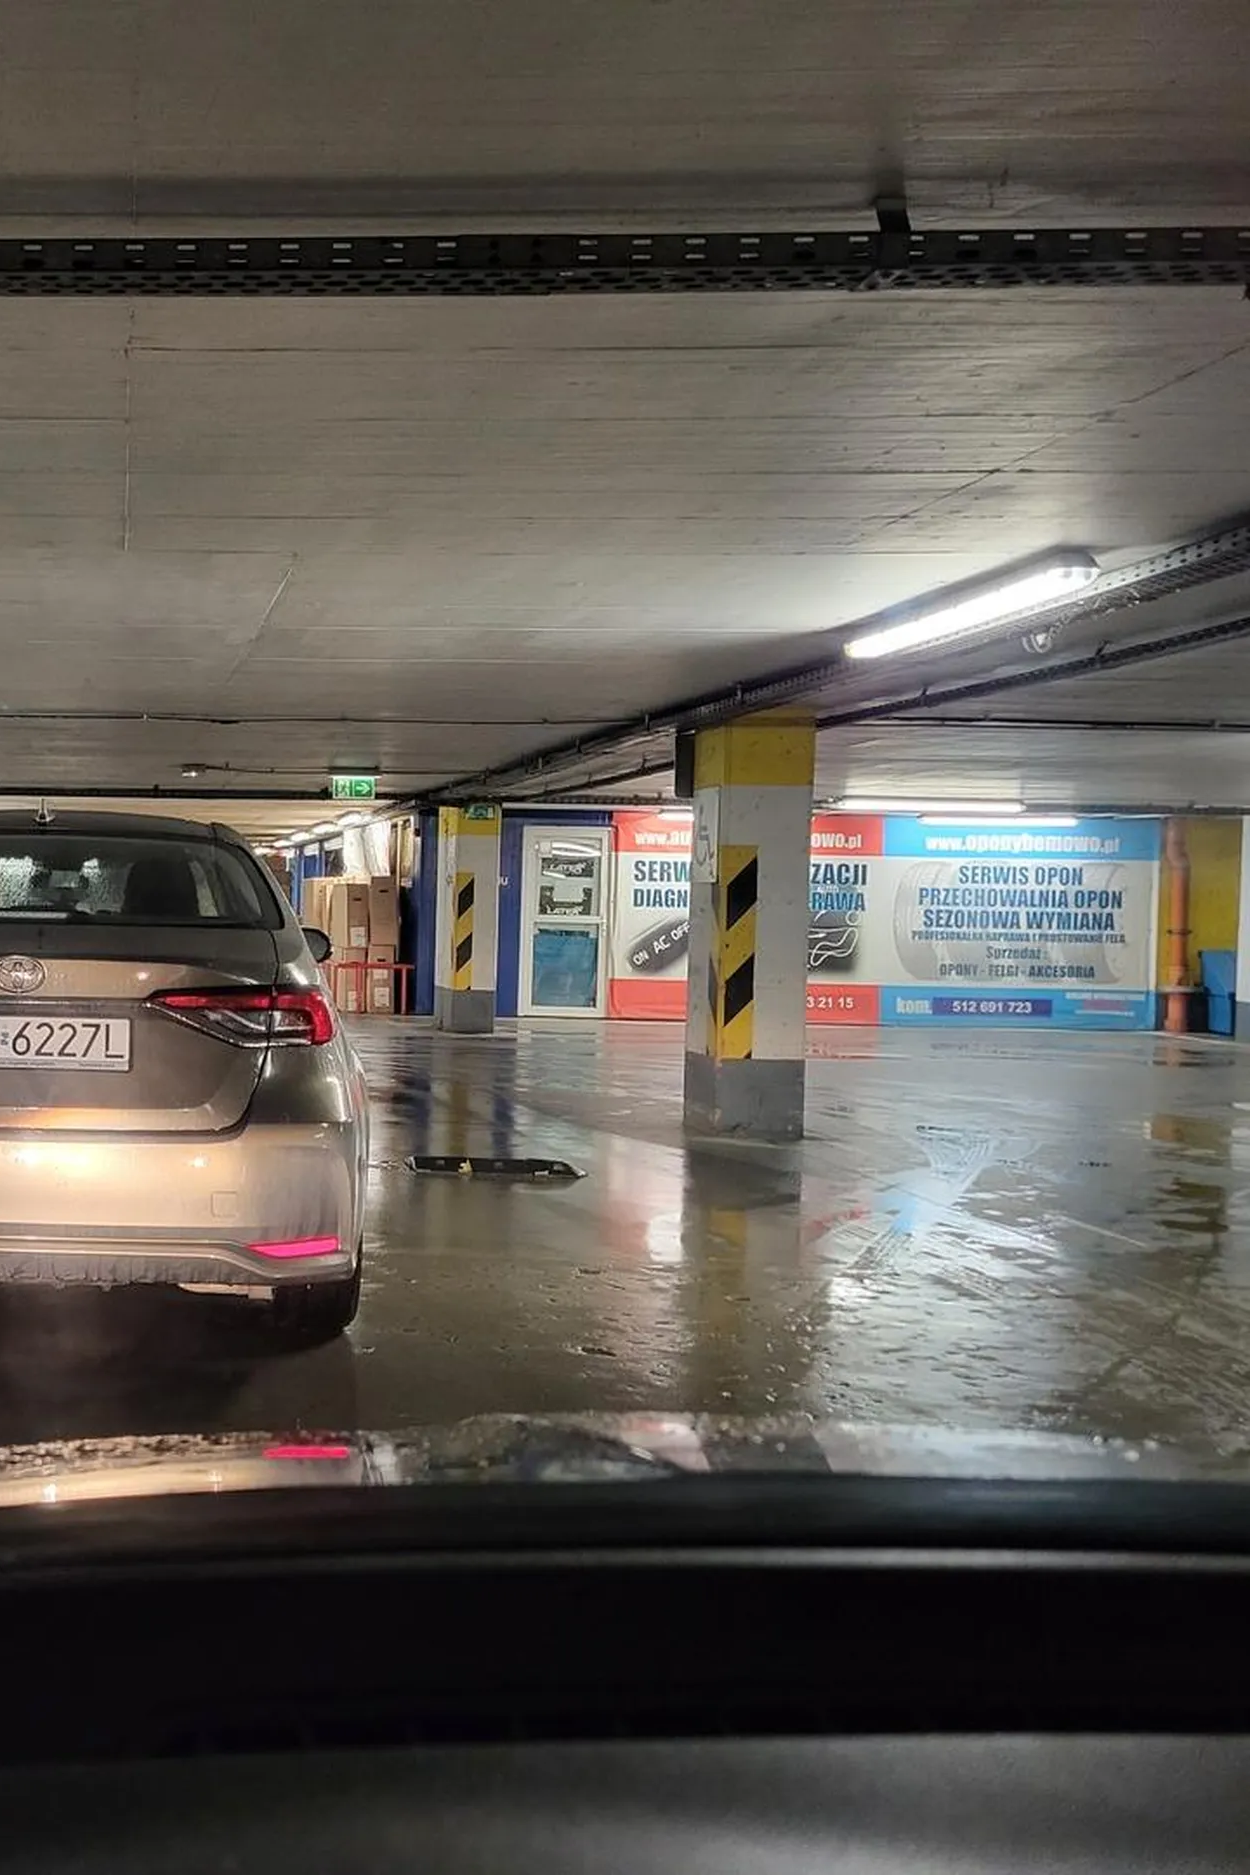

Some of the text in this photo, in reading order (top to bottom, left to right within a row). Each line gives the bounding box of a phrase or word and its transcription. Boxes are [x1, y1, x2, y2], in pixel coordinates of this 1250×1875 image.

[925, 833, 1120, 854] www.oponybemowo.pl
[811, 863, 867, 886] ZACJI
[958, 865, 1083, 886] SERWIS OPON
[633, 888, 688, 908] DIAGN
[811, 891, 866, 911] RAWA
[918, 888, 1123, 909] PRZECHOWALNIA OPON
[923, 909, 1115, 931] SEZONOWA WYMIANA
[632, 949, 649, 966] ON
[652, 934, 670, 955] AC
[939, 963, 978, 978] OPONY
[988, 964, 1019, 978] FELGI
[1027, 964, 1095, 979] AKCESORIA
[819, 996, 833, 1008] 21
[838, 997, 854, 1009] 15
[896, 997, 1032, 1015] kom. 512 691 723
[11, 1021, 125, 1059] 6227L
